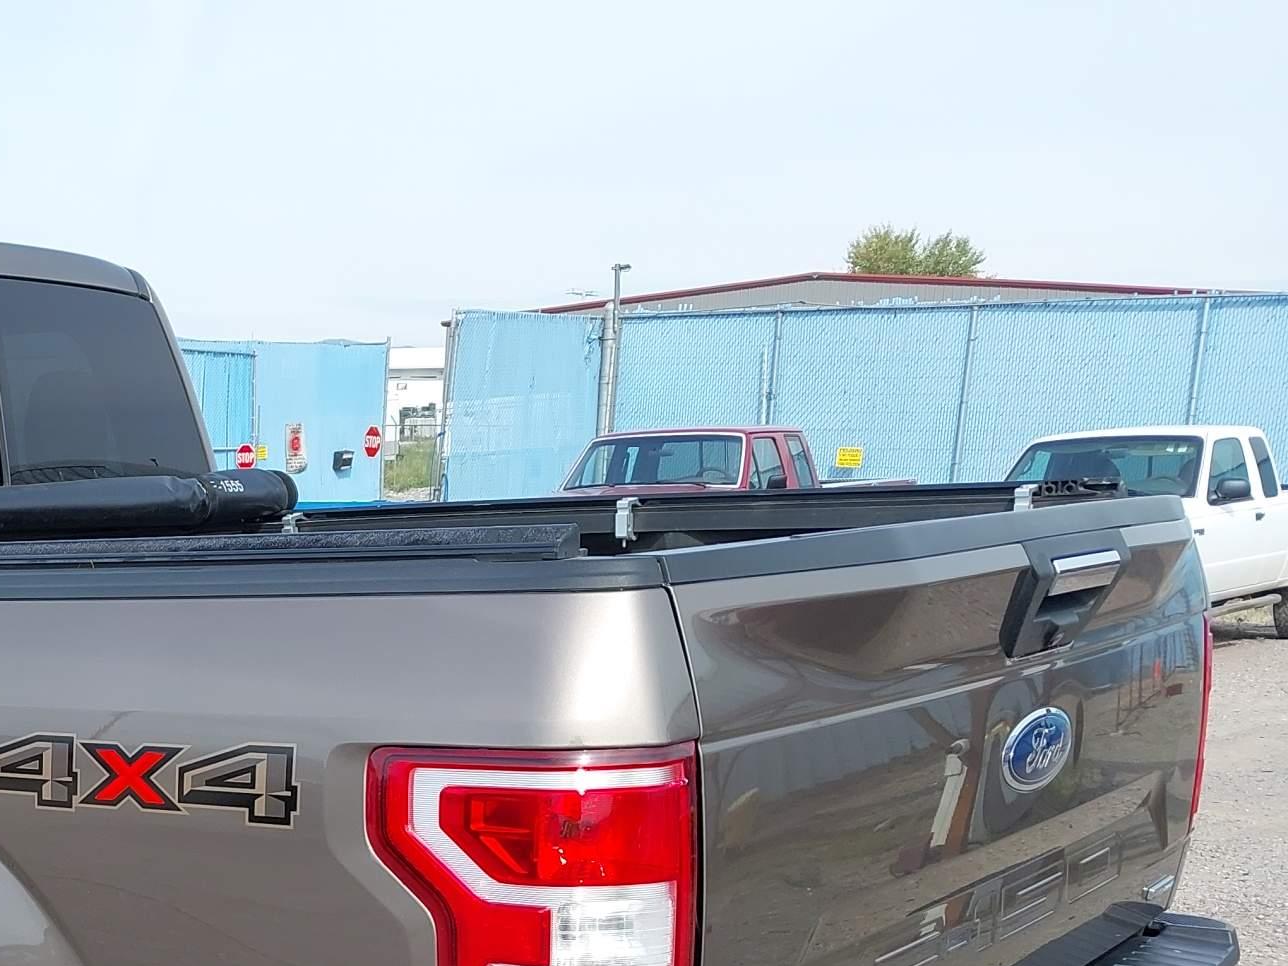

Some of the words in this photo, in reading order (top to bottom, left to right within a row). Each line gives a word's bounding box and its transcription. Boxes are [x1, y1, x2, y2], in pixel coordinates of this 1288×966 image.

[365, 435, 381, 449] STOP
[236, 452, 256, 464] STOP
[1025, 724, 1066, 774] Ford
